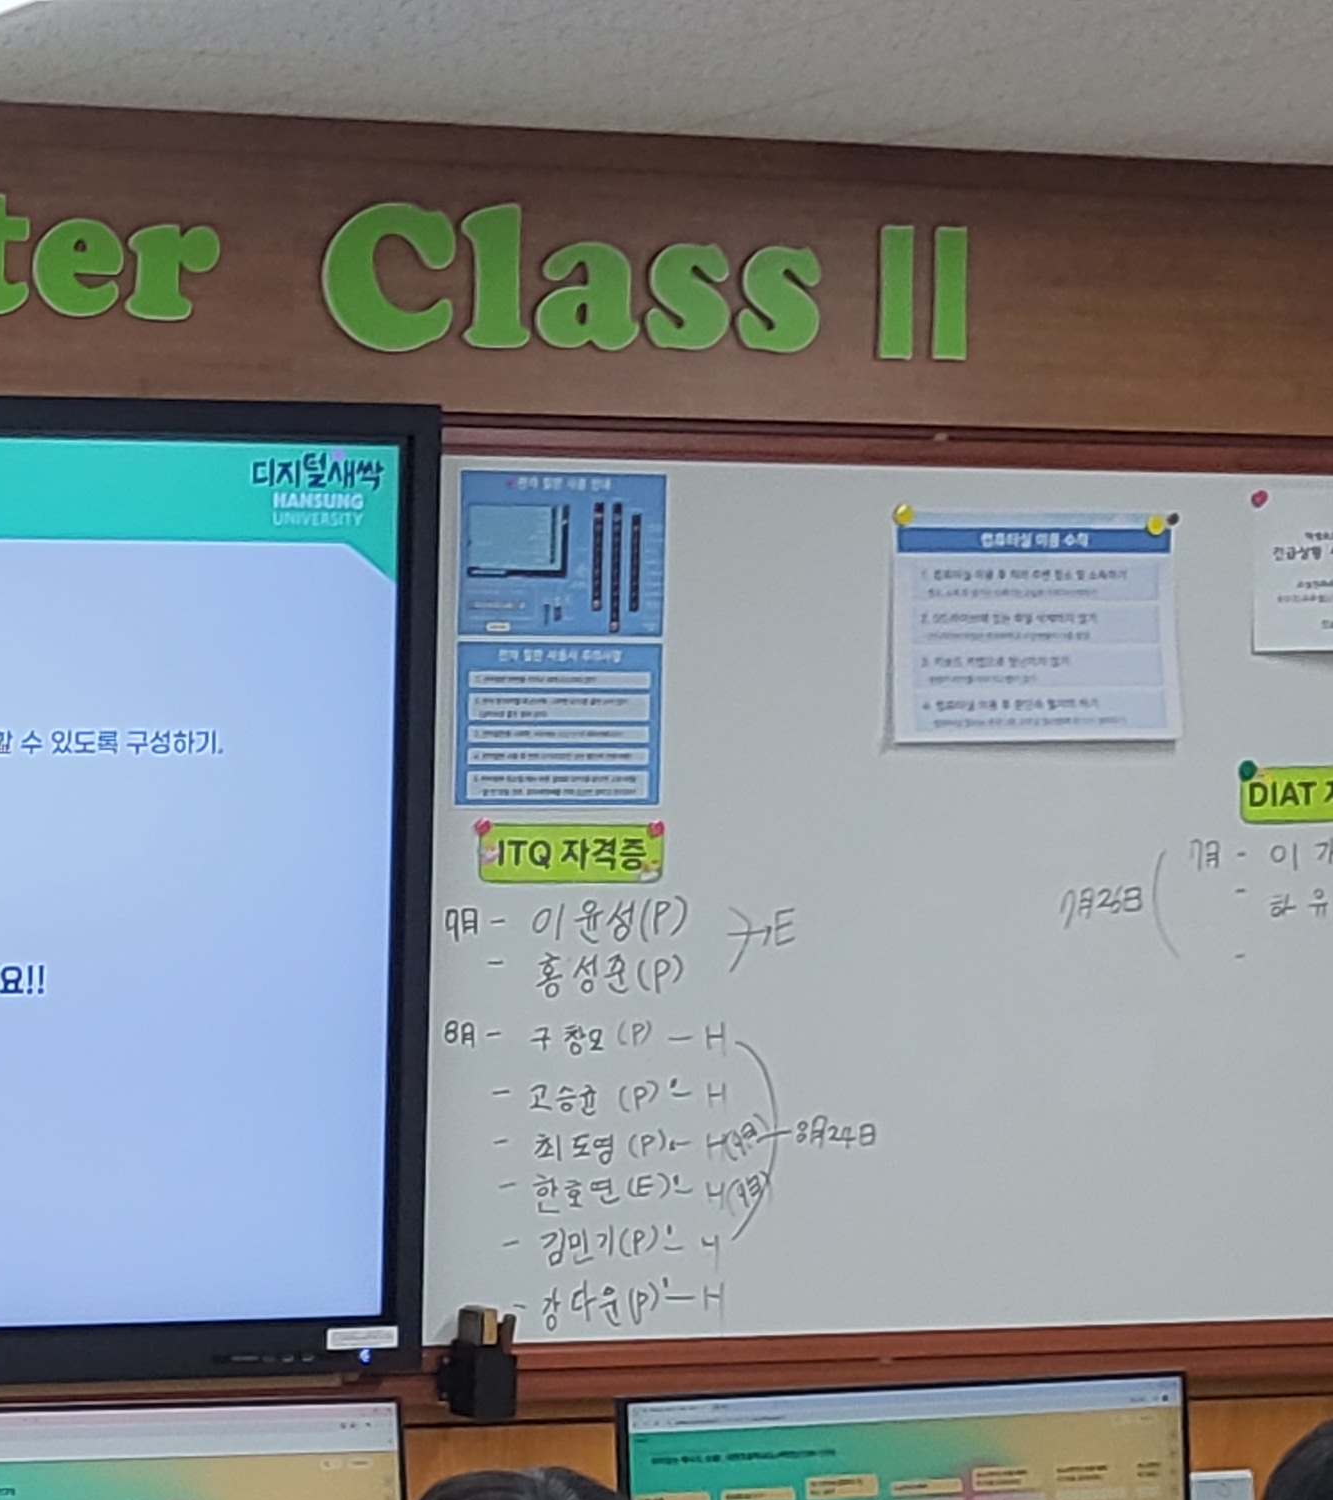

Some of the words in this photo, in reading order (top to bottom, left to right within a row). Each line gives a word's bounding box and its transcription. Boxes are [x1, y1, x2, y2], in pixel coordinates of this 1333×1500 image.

[322, 201, 823, 353] Class
[252, 452, 385, 491] 디지털새싹
[273, 492, 364, 510] HANSUNG
[273, 512, 363, 527] UNIVERSITY
[21, 731, 42, 754] 수
[52, 731, 118, 754] 있도록
[127, 730, 223, 754] 구성하기.
[1248, 781, 1318, 808] DIAT
[497, 838, 551, 868] ITQ
[560, 838, 648, 872] 자격증
